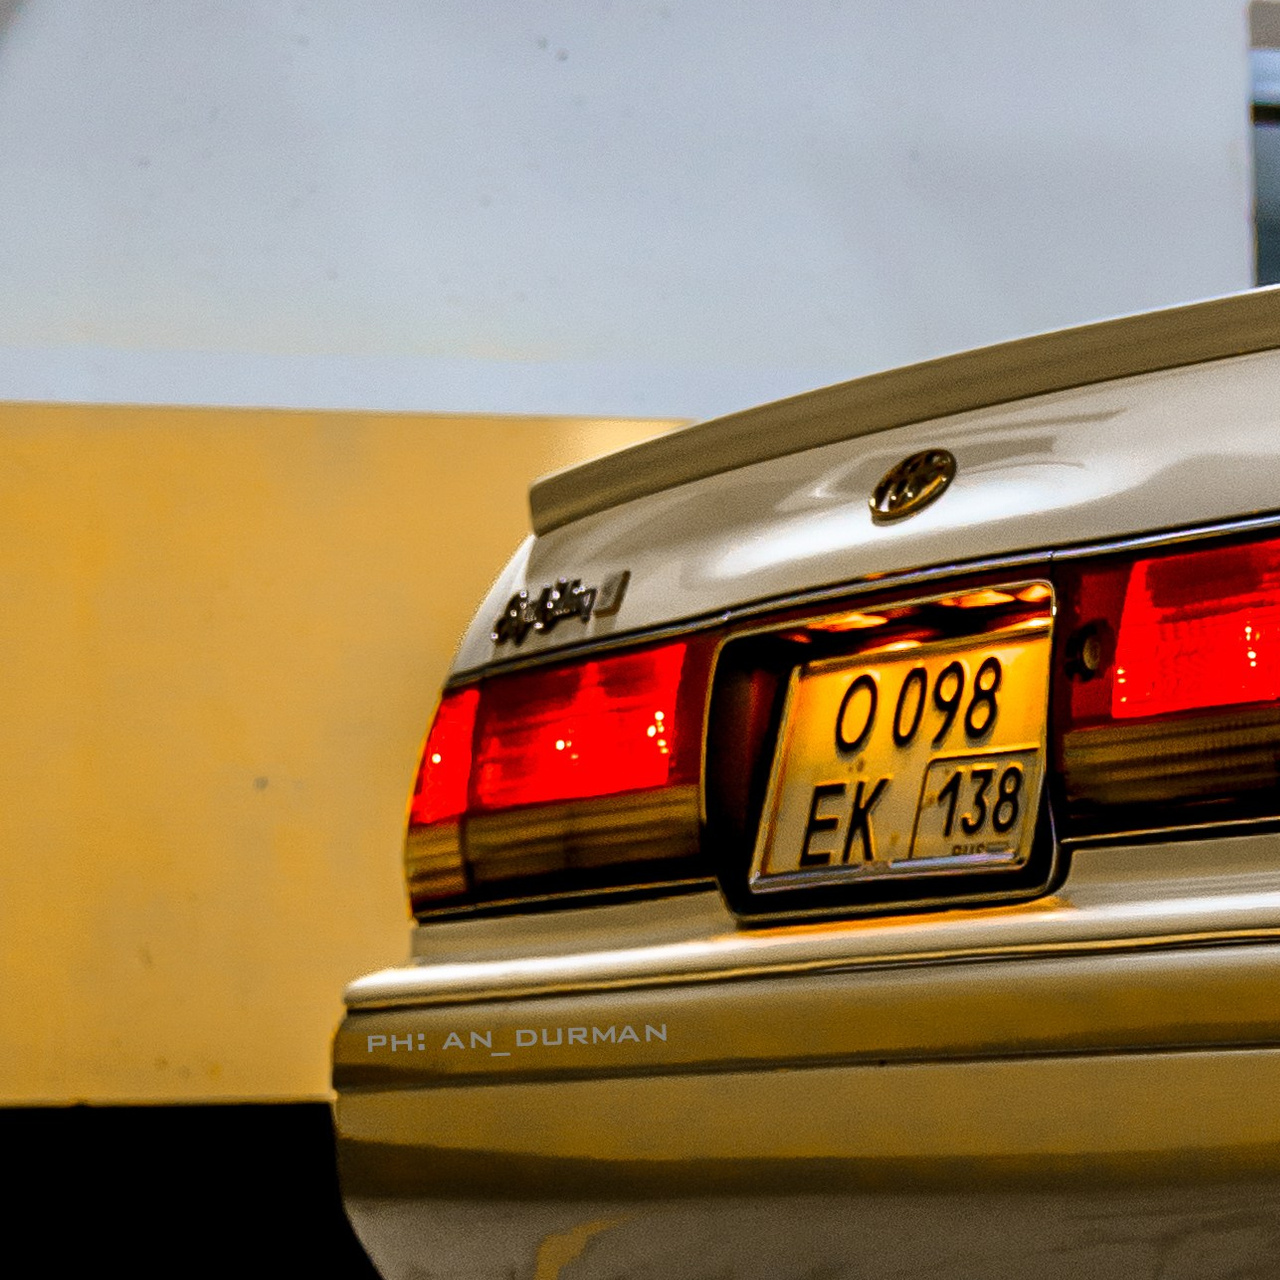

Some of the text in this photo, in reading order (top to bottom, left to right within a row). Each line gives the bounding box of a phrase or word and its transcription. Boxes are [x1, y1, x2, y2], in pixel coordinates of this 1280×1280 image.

[893, 657, 1001, 748] 098
[800, 778, 891, 868] EK
[937, 766, 1024, 838] 138
